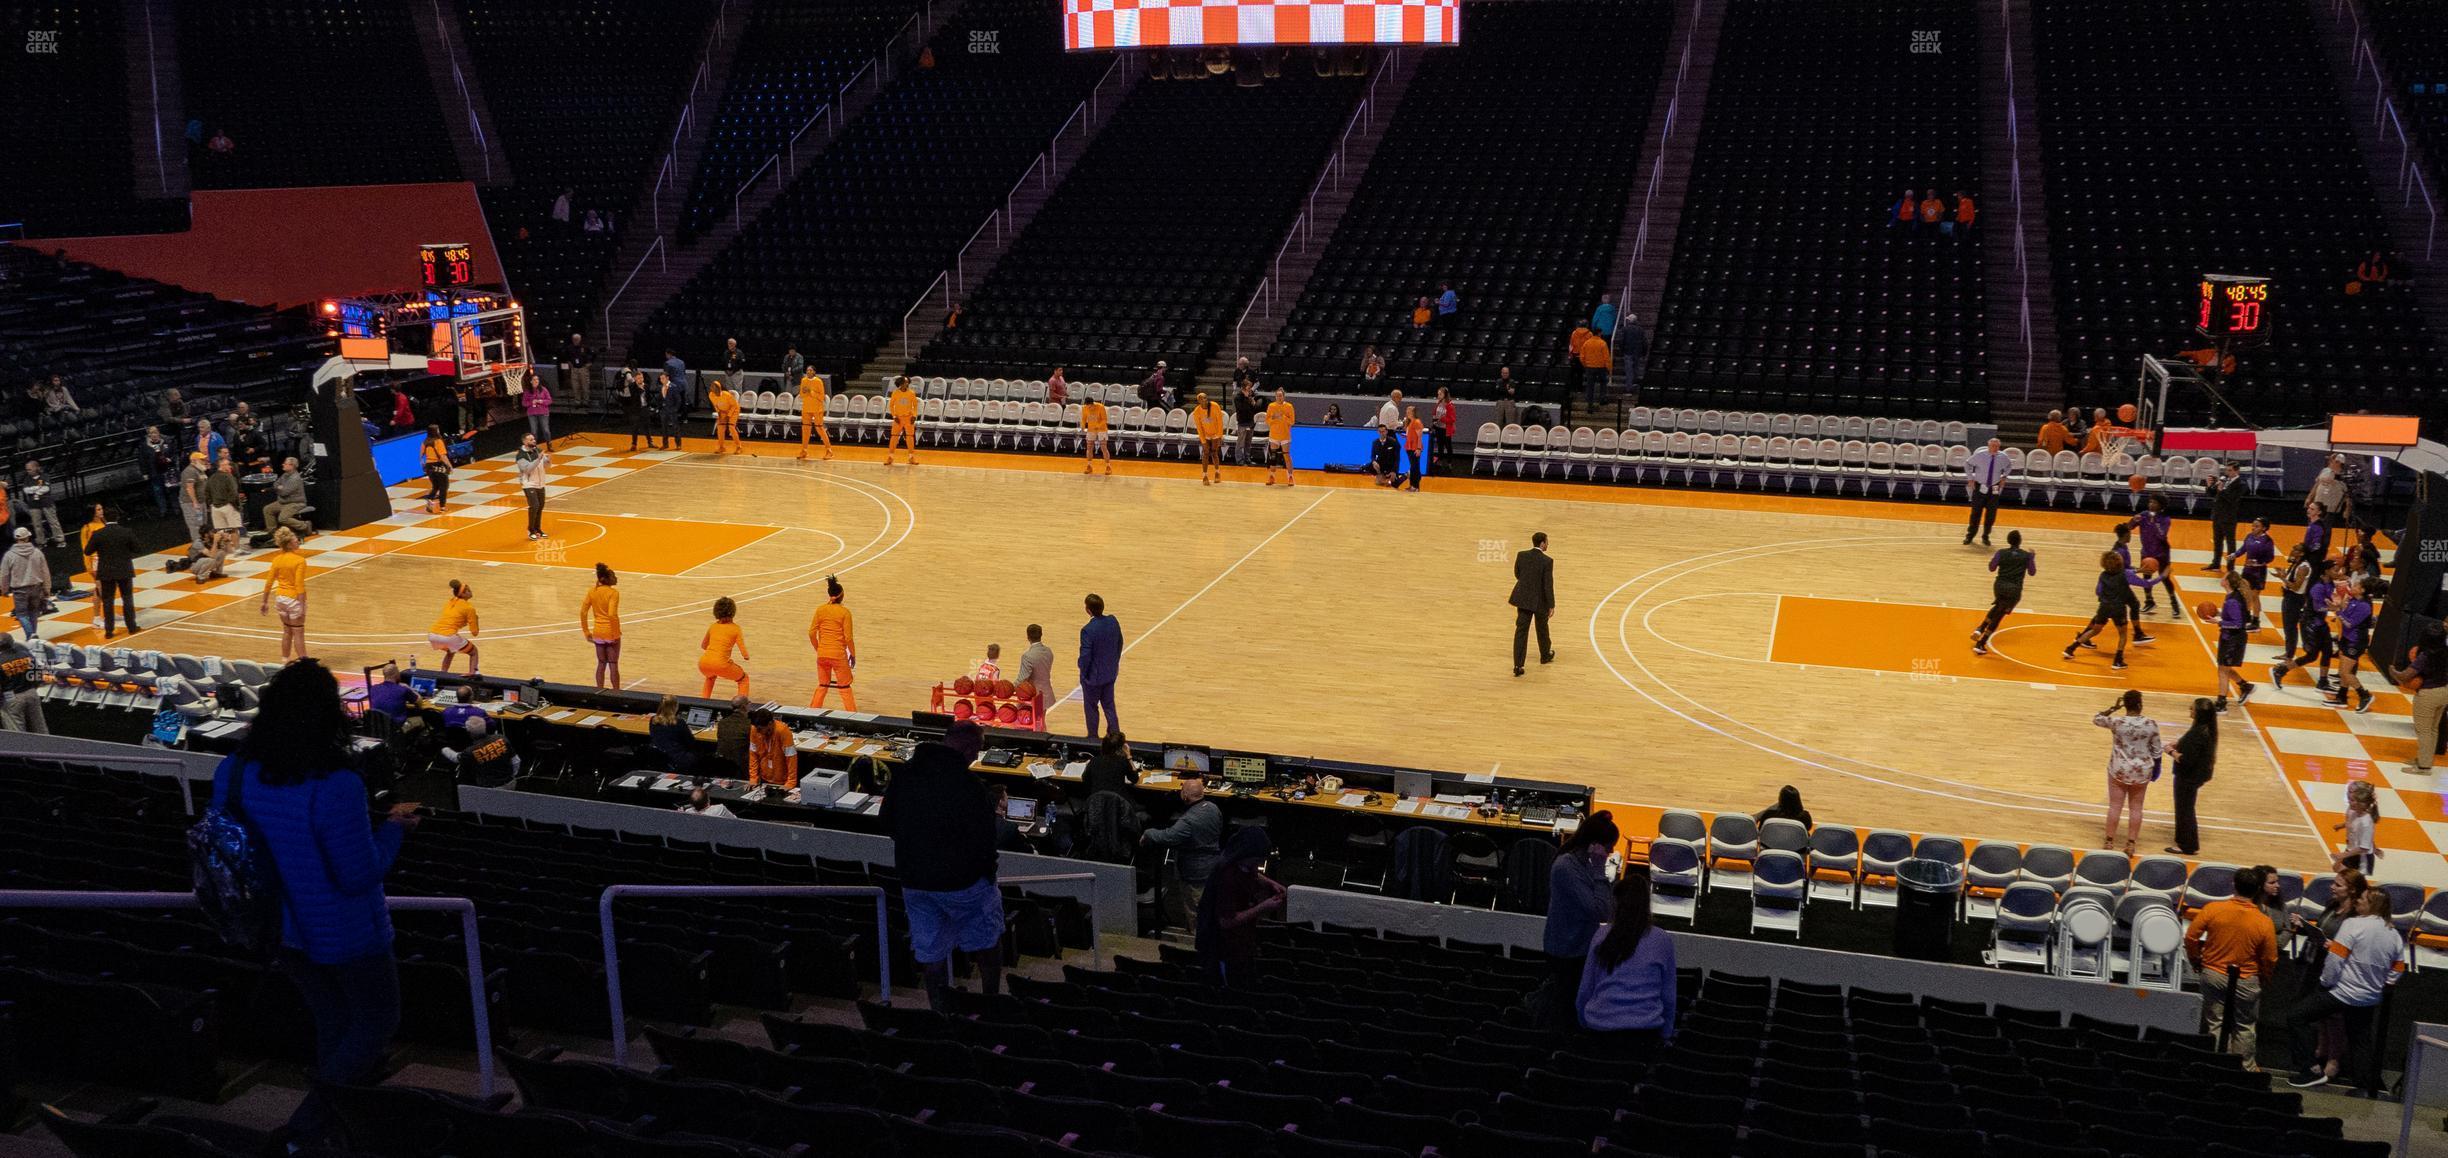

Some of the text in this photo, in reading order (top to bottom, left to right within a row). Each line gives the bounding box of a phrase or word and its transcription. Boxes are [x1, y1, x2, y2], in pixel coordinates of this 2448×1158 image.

[444, 248, 470, 261] 48:45
[450, 262, 468, 284] 30
[2226, 284, 2267, 301] 48:45
[2228, 302, 2260, 331] 30
[472, 738, 506, 758] EVENT
[475, 747, 508, 762] STAFF
